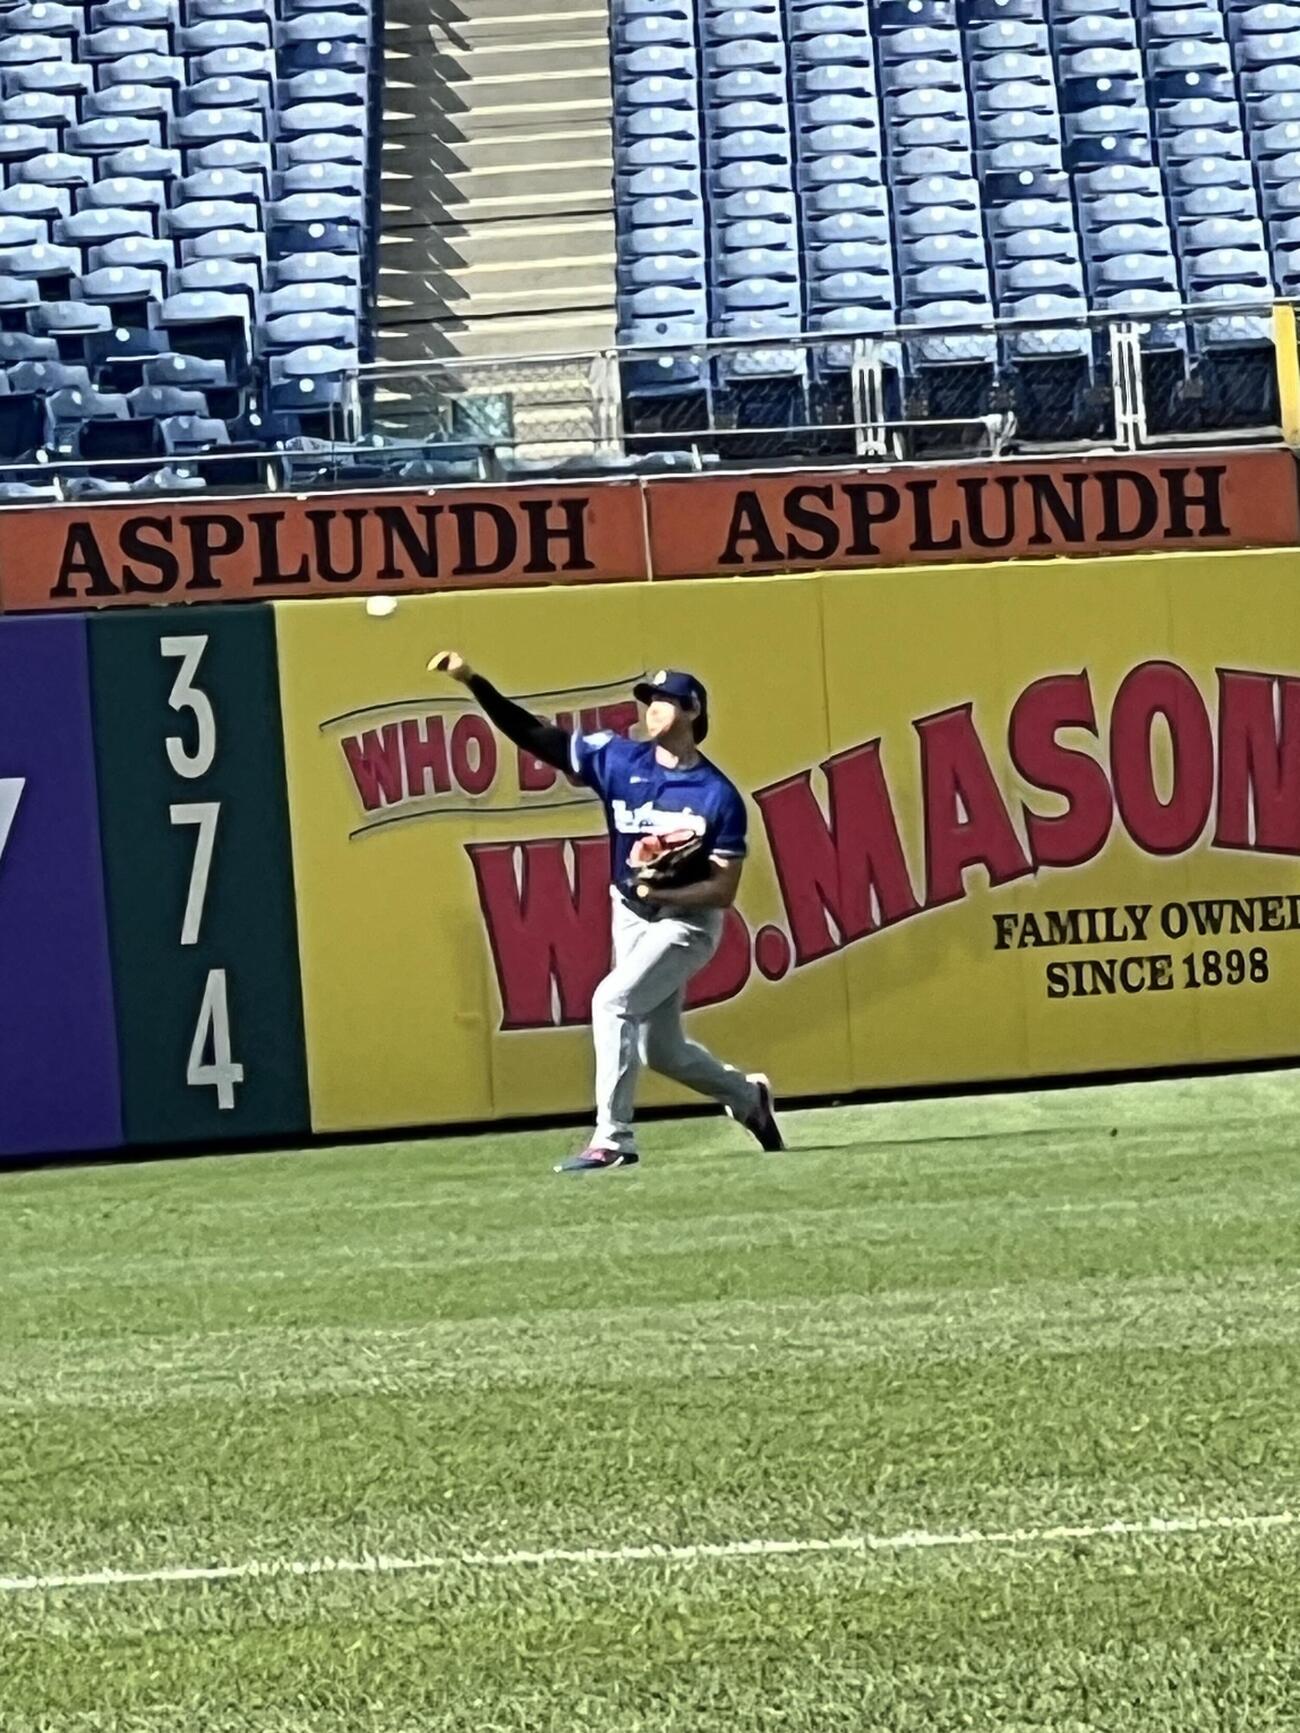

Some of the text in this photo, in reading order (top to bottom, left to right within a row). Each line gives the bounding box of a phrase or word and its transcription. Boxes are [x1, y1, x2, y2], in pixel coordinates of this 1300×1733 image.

[50, 498, 595, 598] ASPLUNDH
[718, 465, 1231, 565] ASPLUNDH
[341, 714, 497, 811] WHO
[160, 635, 244, 1110] 374
[992, 904, 1153, 950] FAMILY
[1046, 947, 1269, 998] SINCE 1898
